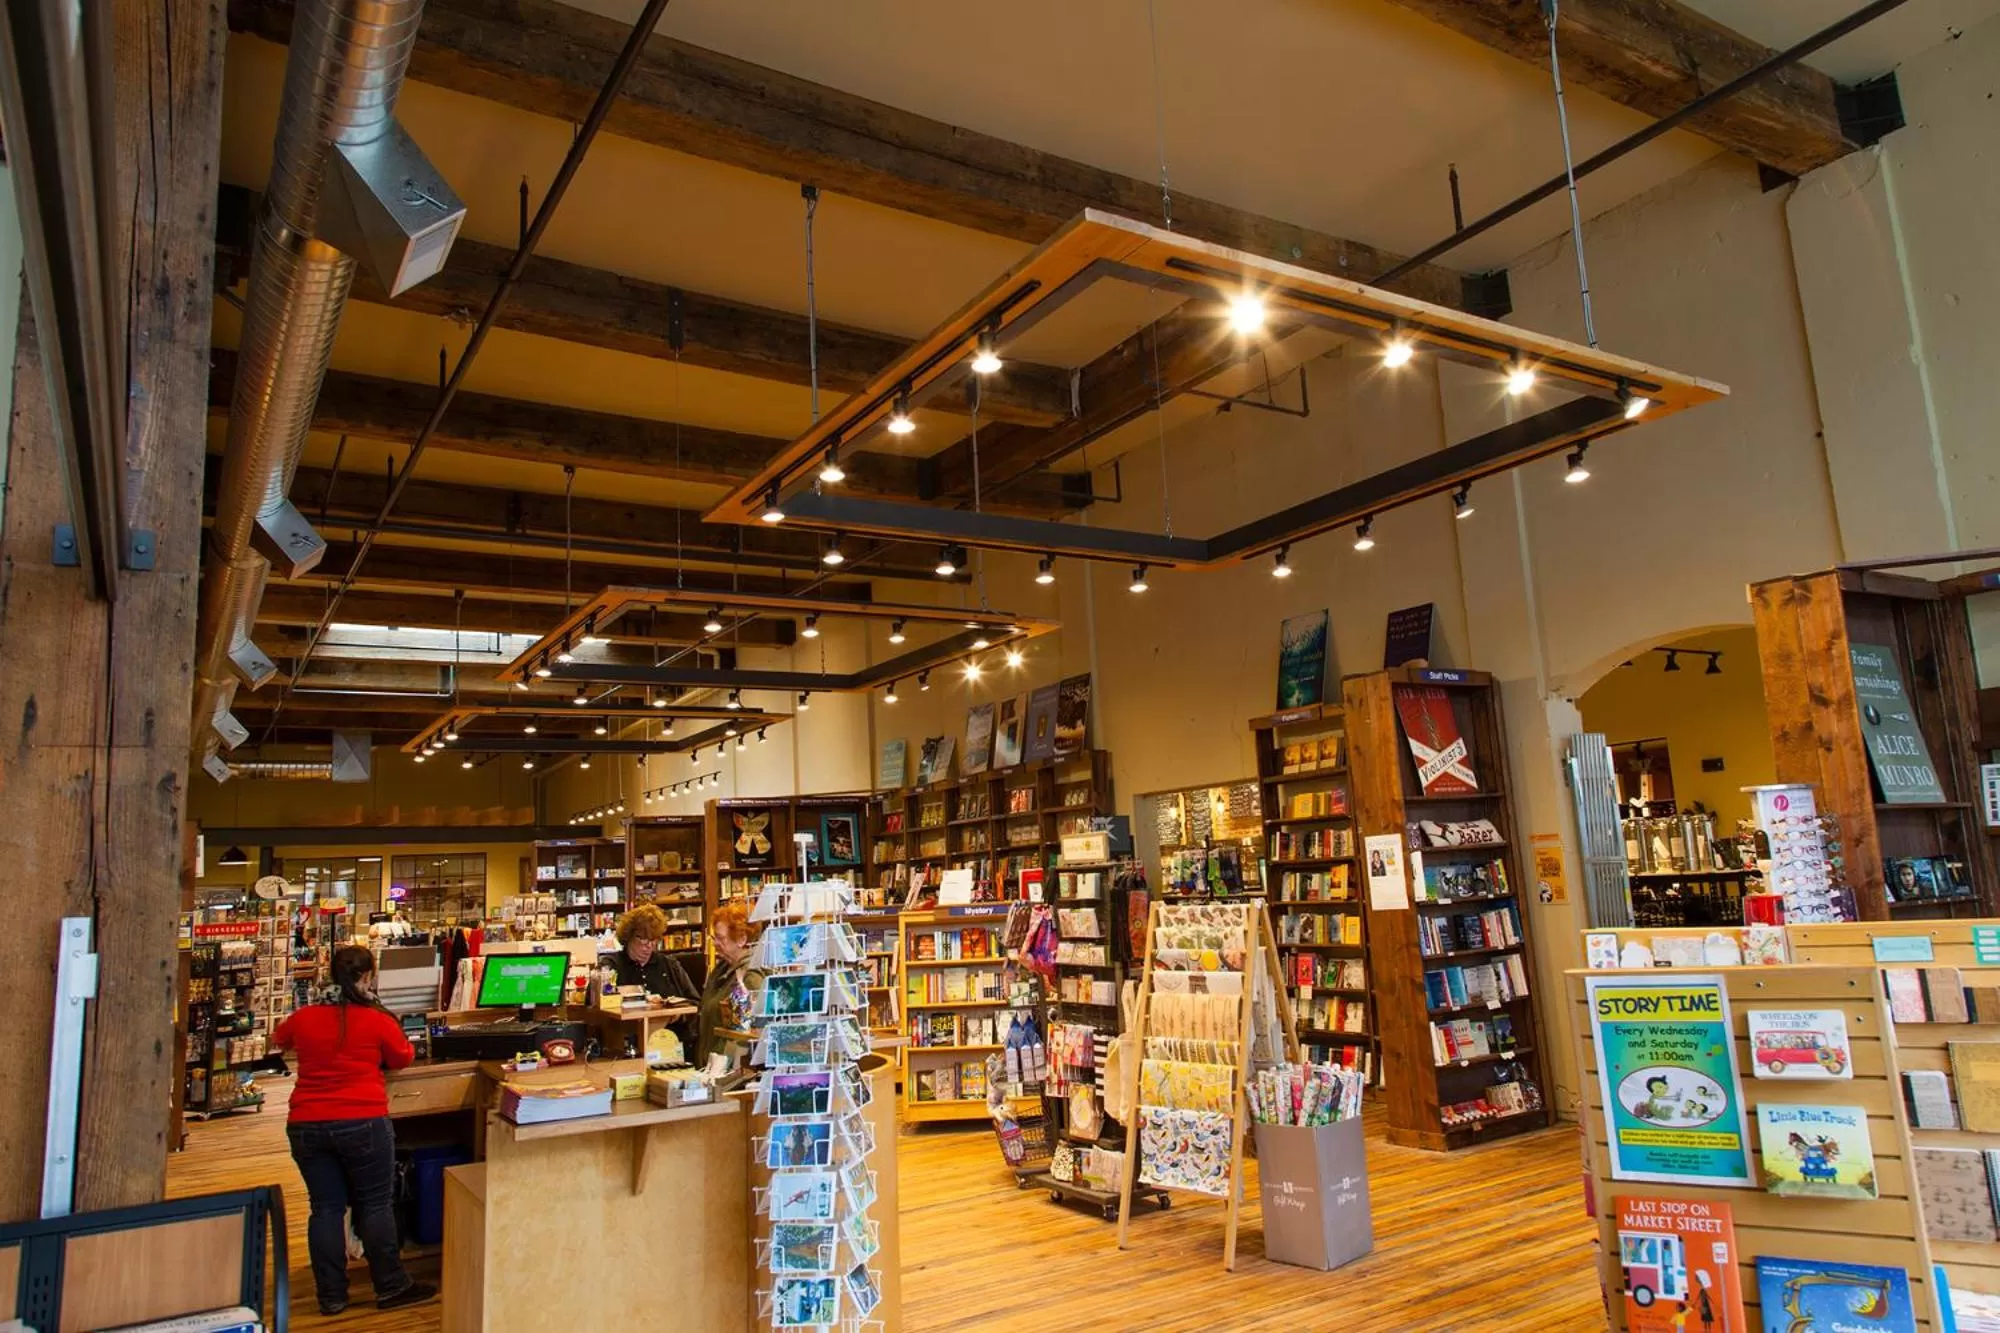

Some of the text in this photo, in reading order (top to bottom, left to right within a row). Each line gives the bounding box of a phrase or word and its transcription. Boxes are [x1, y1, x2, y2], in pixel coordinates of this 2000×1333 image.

[1851, 650, 1882, 673] Family
[1855, 674, 1900, 695] urnishings
[1876, 734, 1920, 756] ALICE
[1880, 764, 1935, 787] MUNRO
[1614, 1025, 1708, 1037] Every Wednesday
[1628, 1039, 1699, 1050] and Saturday
[1650, 1051, 1694, 1061] 11:00am
[1768, 1110, 1856, 1127] Little Blue Truck
[1630, 1200, 1710, 1216] LAST STOP ON
[1624, 1214, 1722, 1233] MARKET STREET
